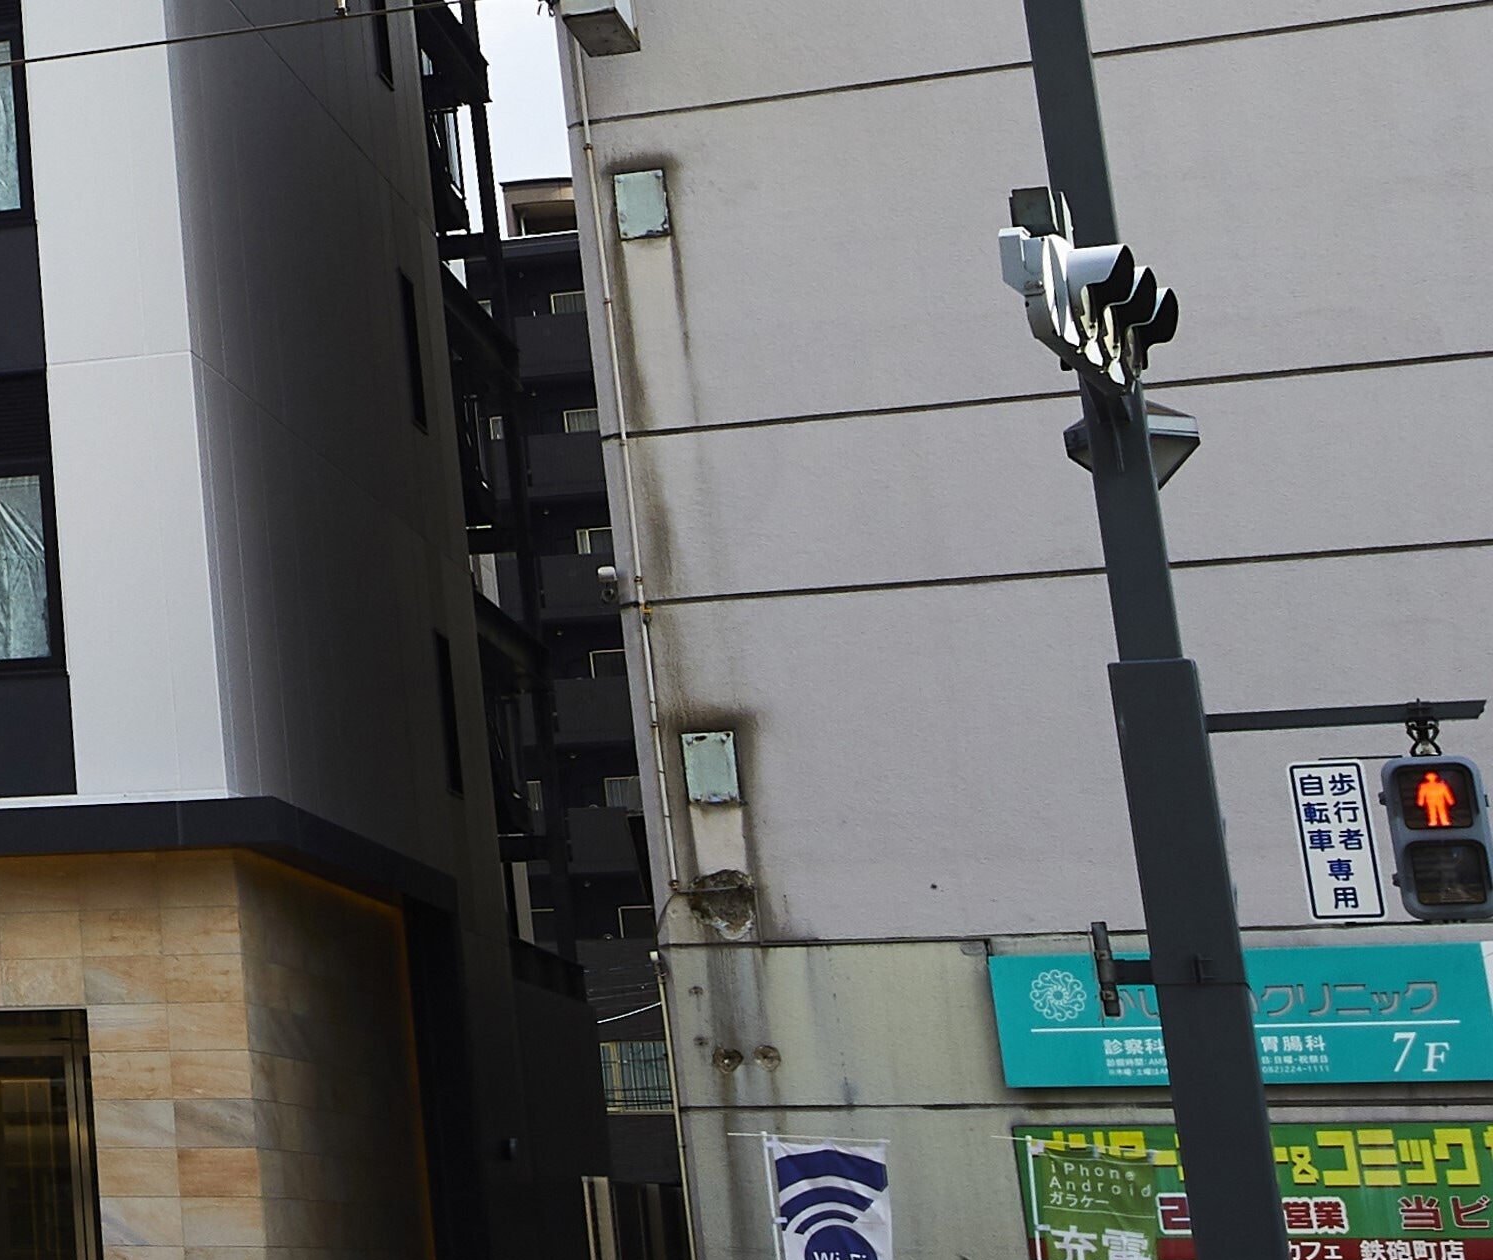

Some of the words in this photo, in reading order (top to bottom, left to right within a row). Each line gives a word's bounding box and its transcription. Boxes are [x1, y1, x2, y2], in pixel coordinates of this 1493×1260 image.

[1299, 773, 1336, 852] 自転車
[1328, 772, 1365, 851] 歩行者
[1326, 858, 1360, 910] 専用
[1249, 981, 1439, 1018] クリニック
[1392, 1031, 1451, 1073] 7F
[1050, 1161, 1136, 1181] iPhone
[1272, 1127, 1493, 1187] &コミック
[1049, 1179, 1152, 1198] Android
[1050, 1192, 1110, 1208] ガラケー
[1281, 1196, 1350, 1234] 営業
